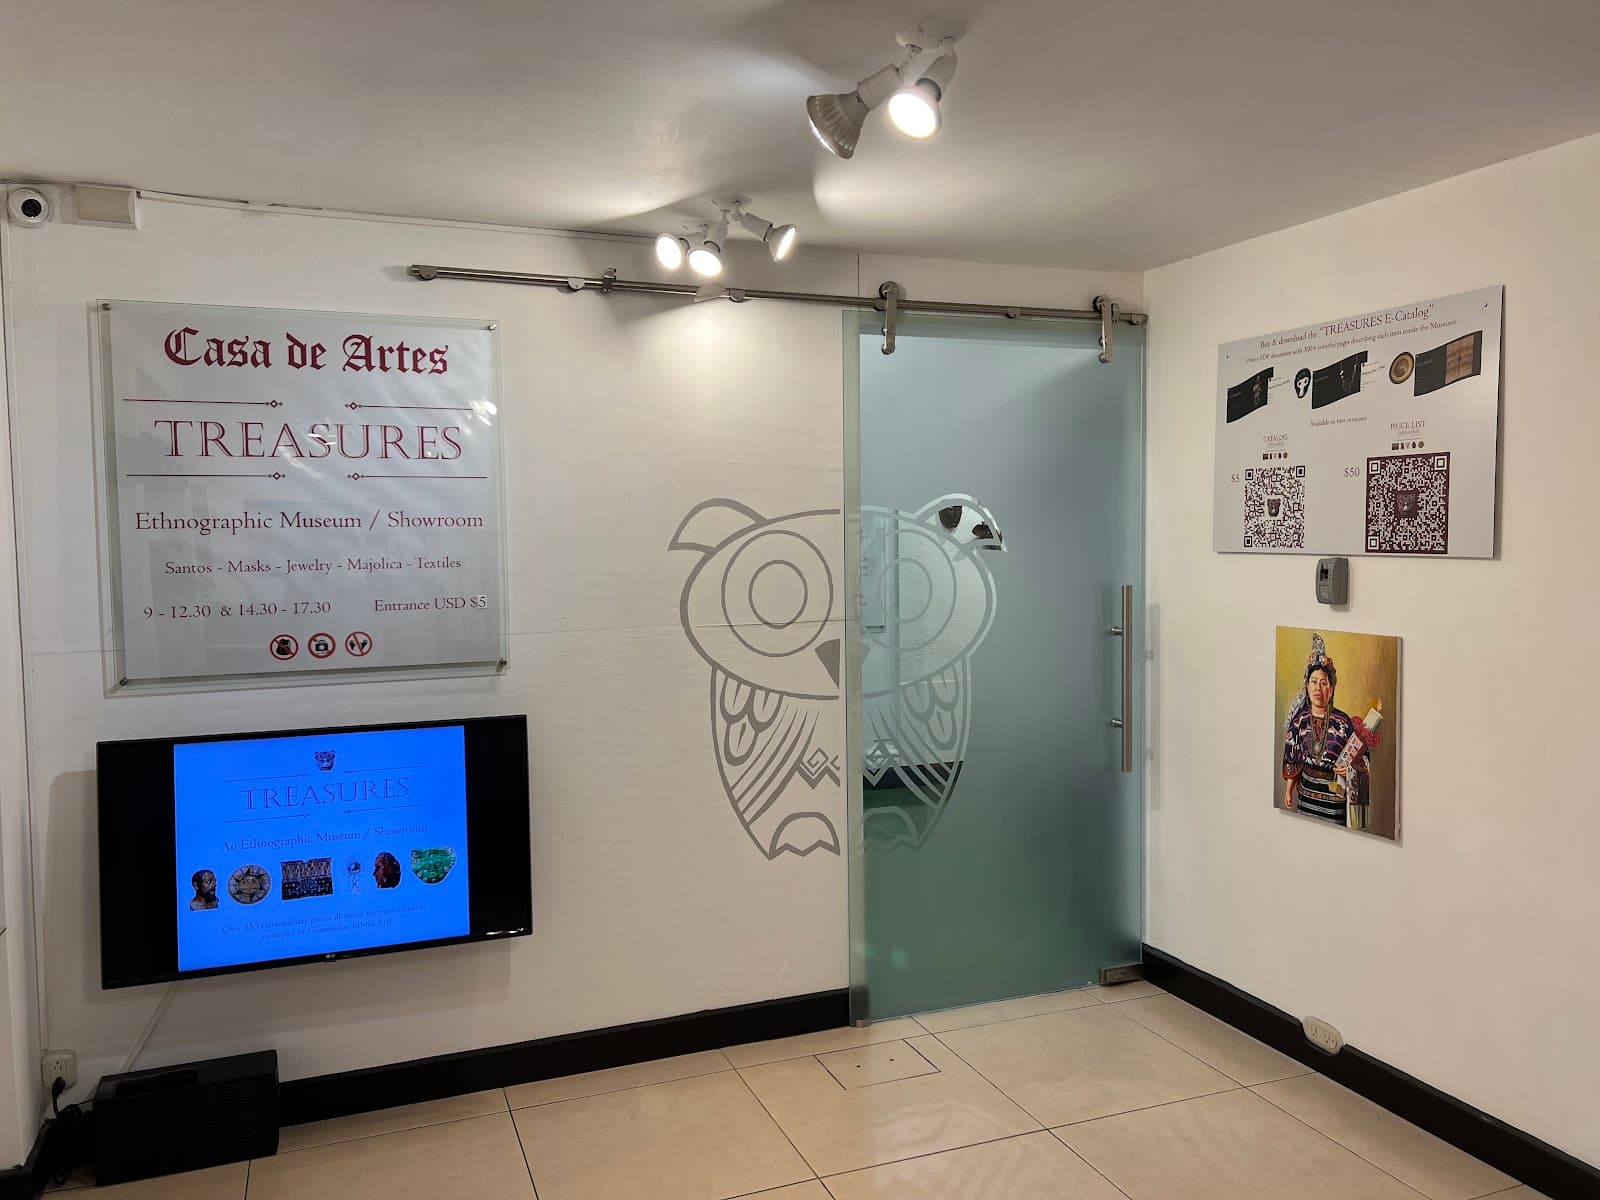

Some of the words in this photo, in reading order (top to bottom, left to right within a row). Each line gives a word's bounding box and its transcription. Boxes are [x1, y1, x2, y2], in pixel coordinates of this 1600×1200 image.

[164, 326, 272, 368] Casa
[286, 332, 327, 369] de
[342, 333, 449, 375] Artes
[1260, 340, 1270, 350] Buy
[1279, 331, 1307, 345] download
[1308, 331, 1318, 340] the
[154, 419, 462, 460] TREASURES
[1343, 466, 1360, 478] $50
[136, 511, 273, 536] Ethnographic
[280, 511, 362, 528] Museum
[369, 508, 381, 531] /
[387, 510, 483, 528] Showroom
[165, 561, 212, 574] Santos
[228, 559, 271, 573] Masks
[286, 558, 332, 575] Jewelry
[347, 557, 402, 573] Majolica
[415, 556, 462, 569] Textiles
[143, 606, 153, 619] 9
[171, 605, 211, 618] 12.30
[220, 605, 232, 617] &
[239, 602, 277, 616] 14.30
[292, 602, 331, 614] 17.30
[374, 599, 430, 612] Entrance
[434, 597, 466, 610] USD
[470, 596, 486, 609] $5
[240, 777, 410, 811] TREASURES
[221, 841, 237, 852] An
[240, 832, 313, 850] Ethnographic
[316, 831, 361, 843] Museum
[374, 824, 428, 837] Showroom
